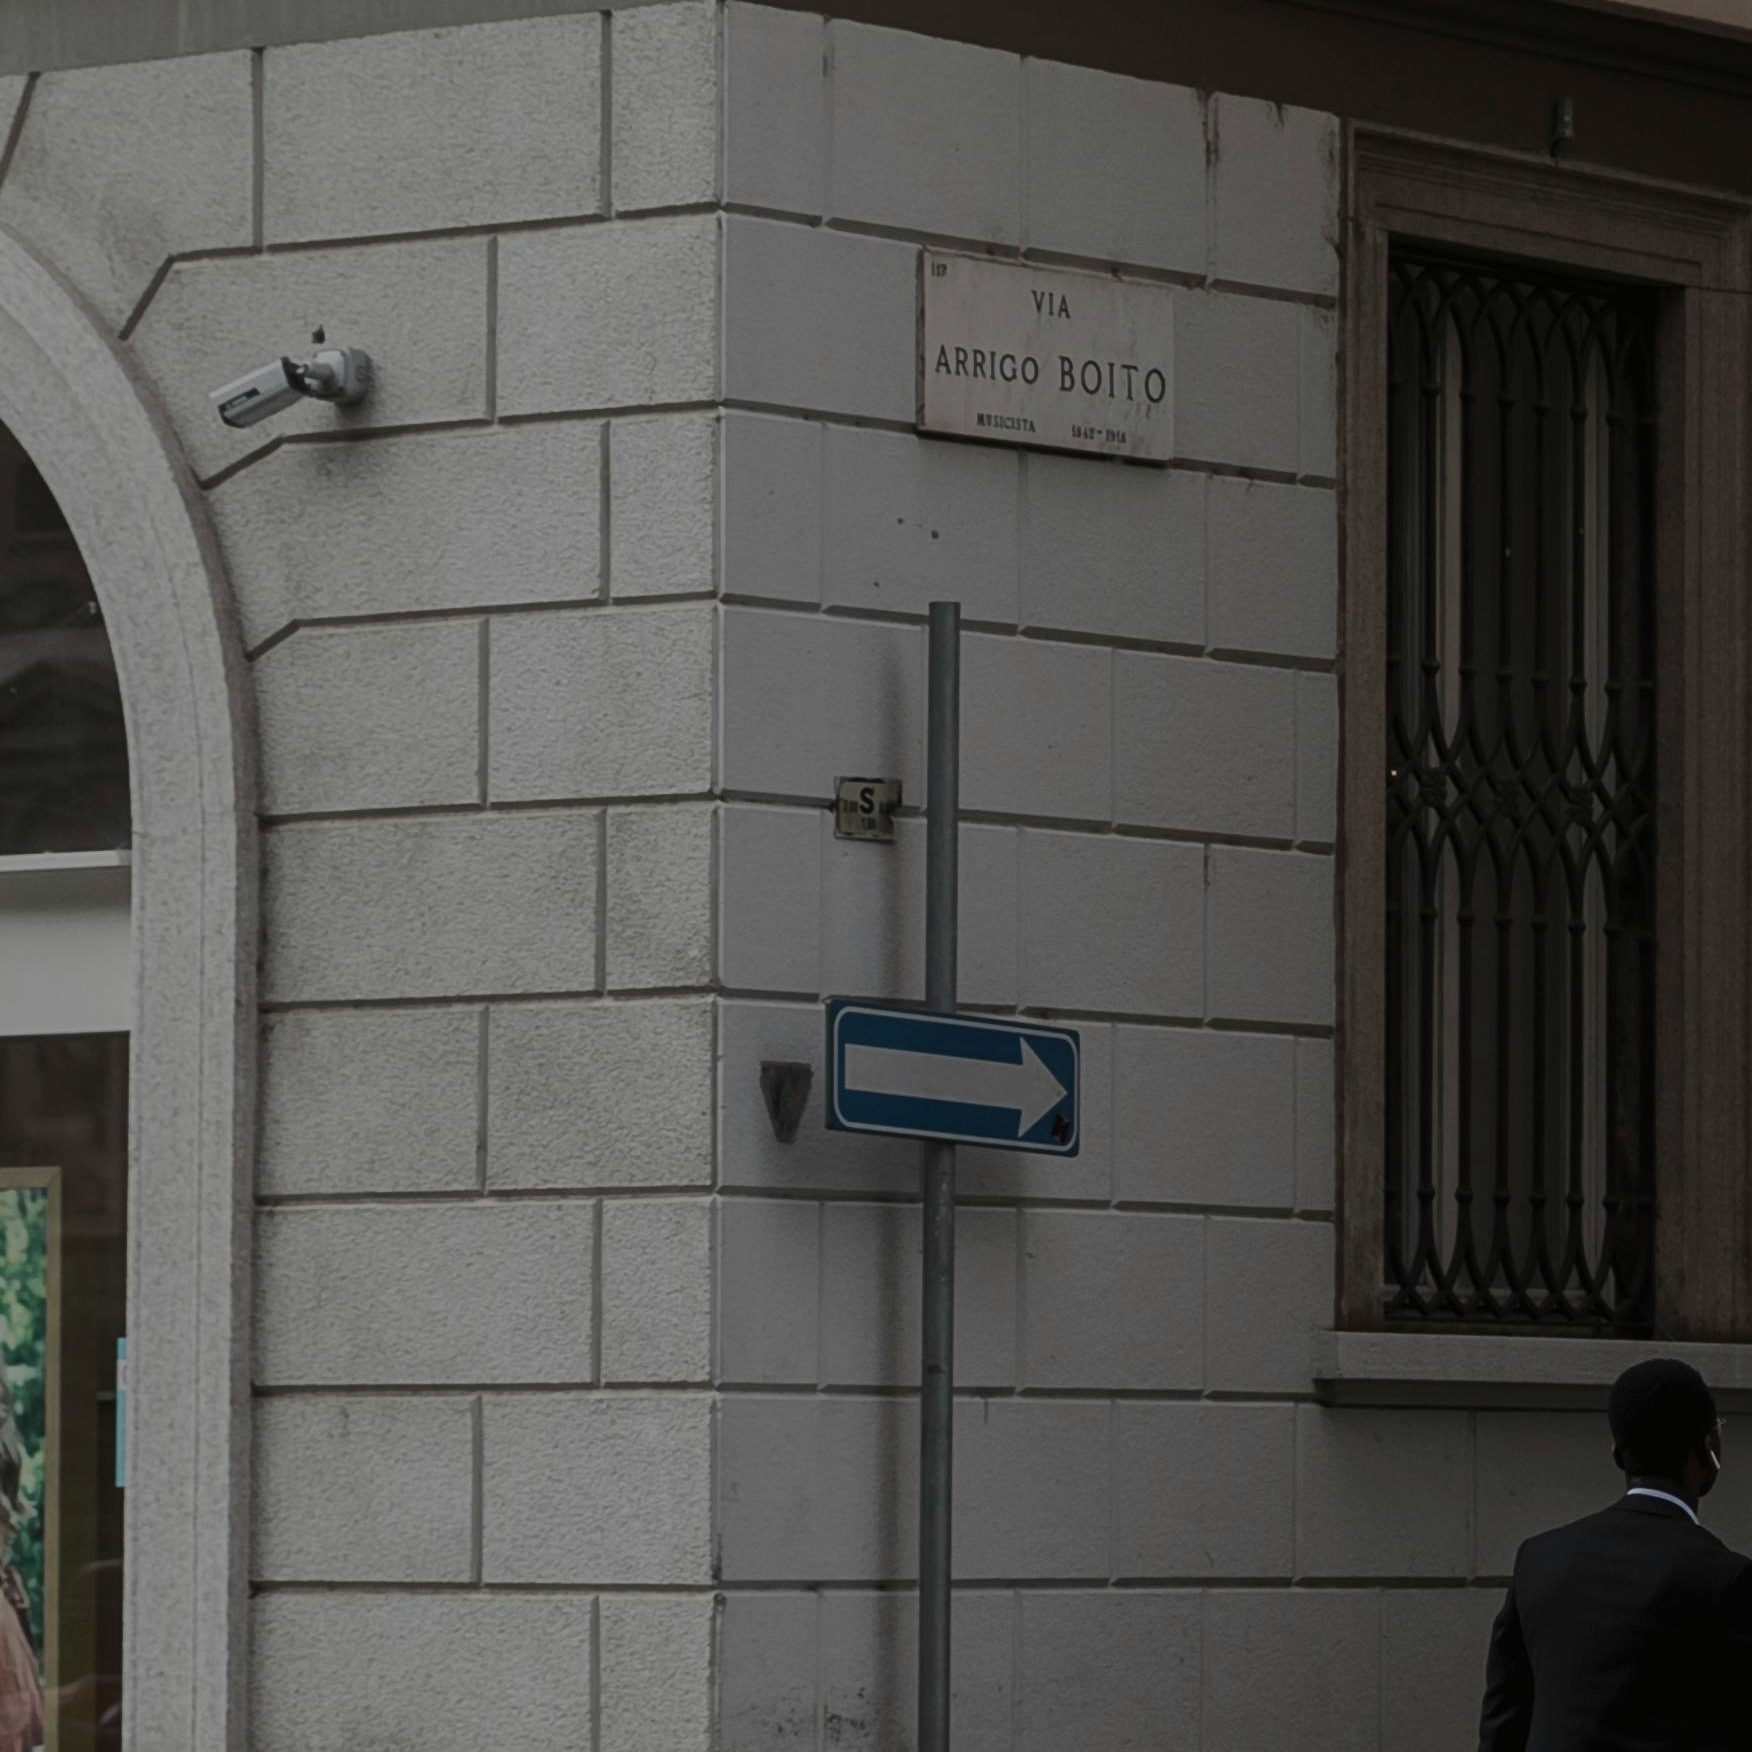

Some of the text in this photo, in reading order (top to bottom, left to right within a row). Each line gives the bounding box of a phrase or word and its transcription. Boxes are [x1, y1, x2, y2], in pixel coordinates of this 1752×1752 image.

[1031, 289, 1071, 319] VIA
[935, 344, 1166, 404] ARRIGO BOITO
[976, 412, 1036, 433] MUSICISTA
[859, 787, 875, 815] S
